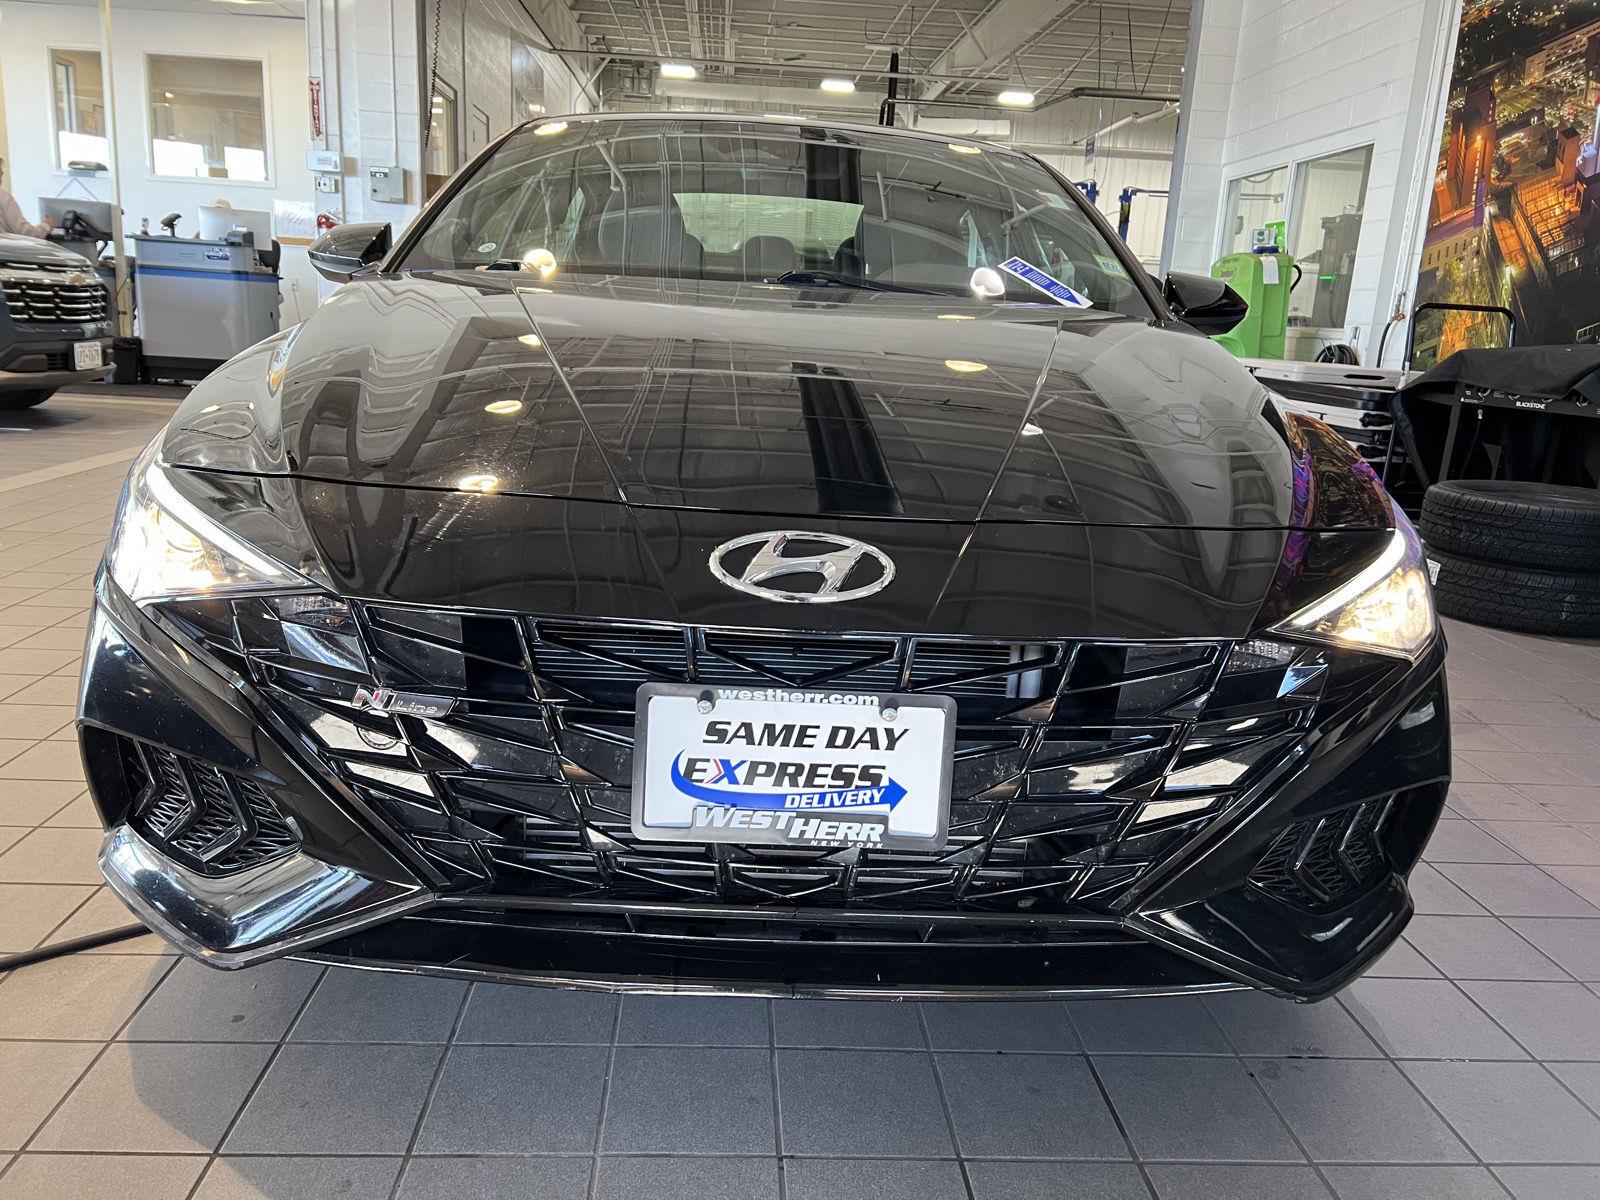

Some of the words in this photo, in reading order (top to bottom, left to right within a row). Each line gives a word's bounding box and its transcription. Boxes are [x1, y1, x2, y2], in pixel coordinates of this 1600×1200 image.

[1516, 401, 1546, 409] BLACKSTONE
[717, 688, 880, 706] westherr.com
[702, 720, 820, 748] SAME
[825, 725, 910, 751] DAY
[683, 757, 886, 789] EXPRESS
[784, 788, 885, 810] DELIVERY
[787, 817, 884, 842] HERR
[848, 841, 883, 849] YORK
